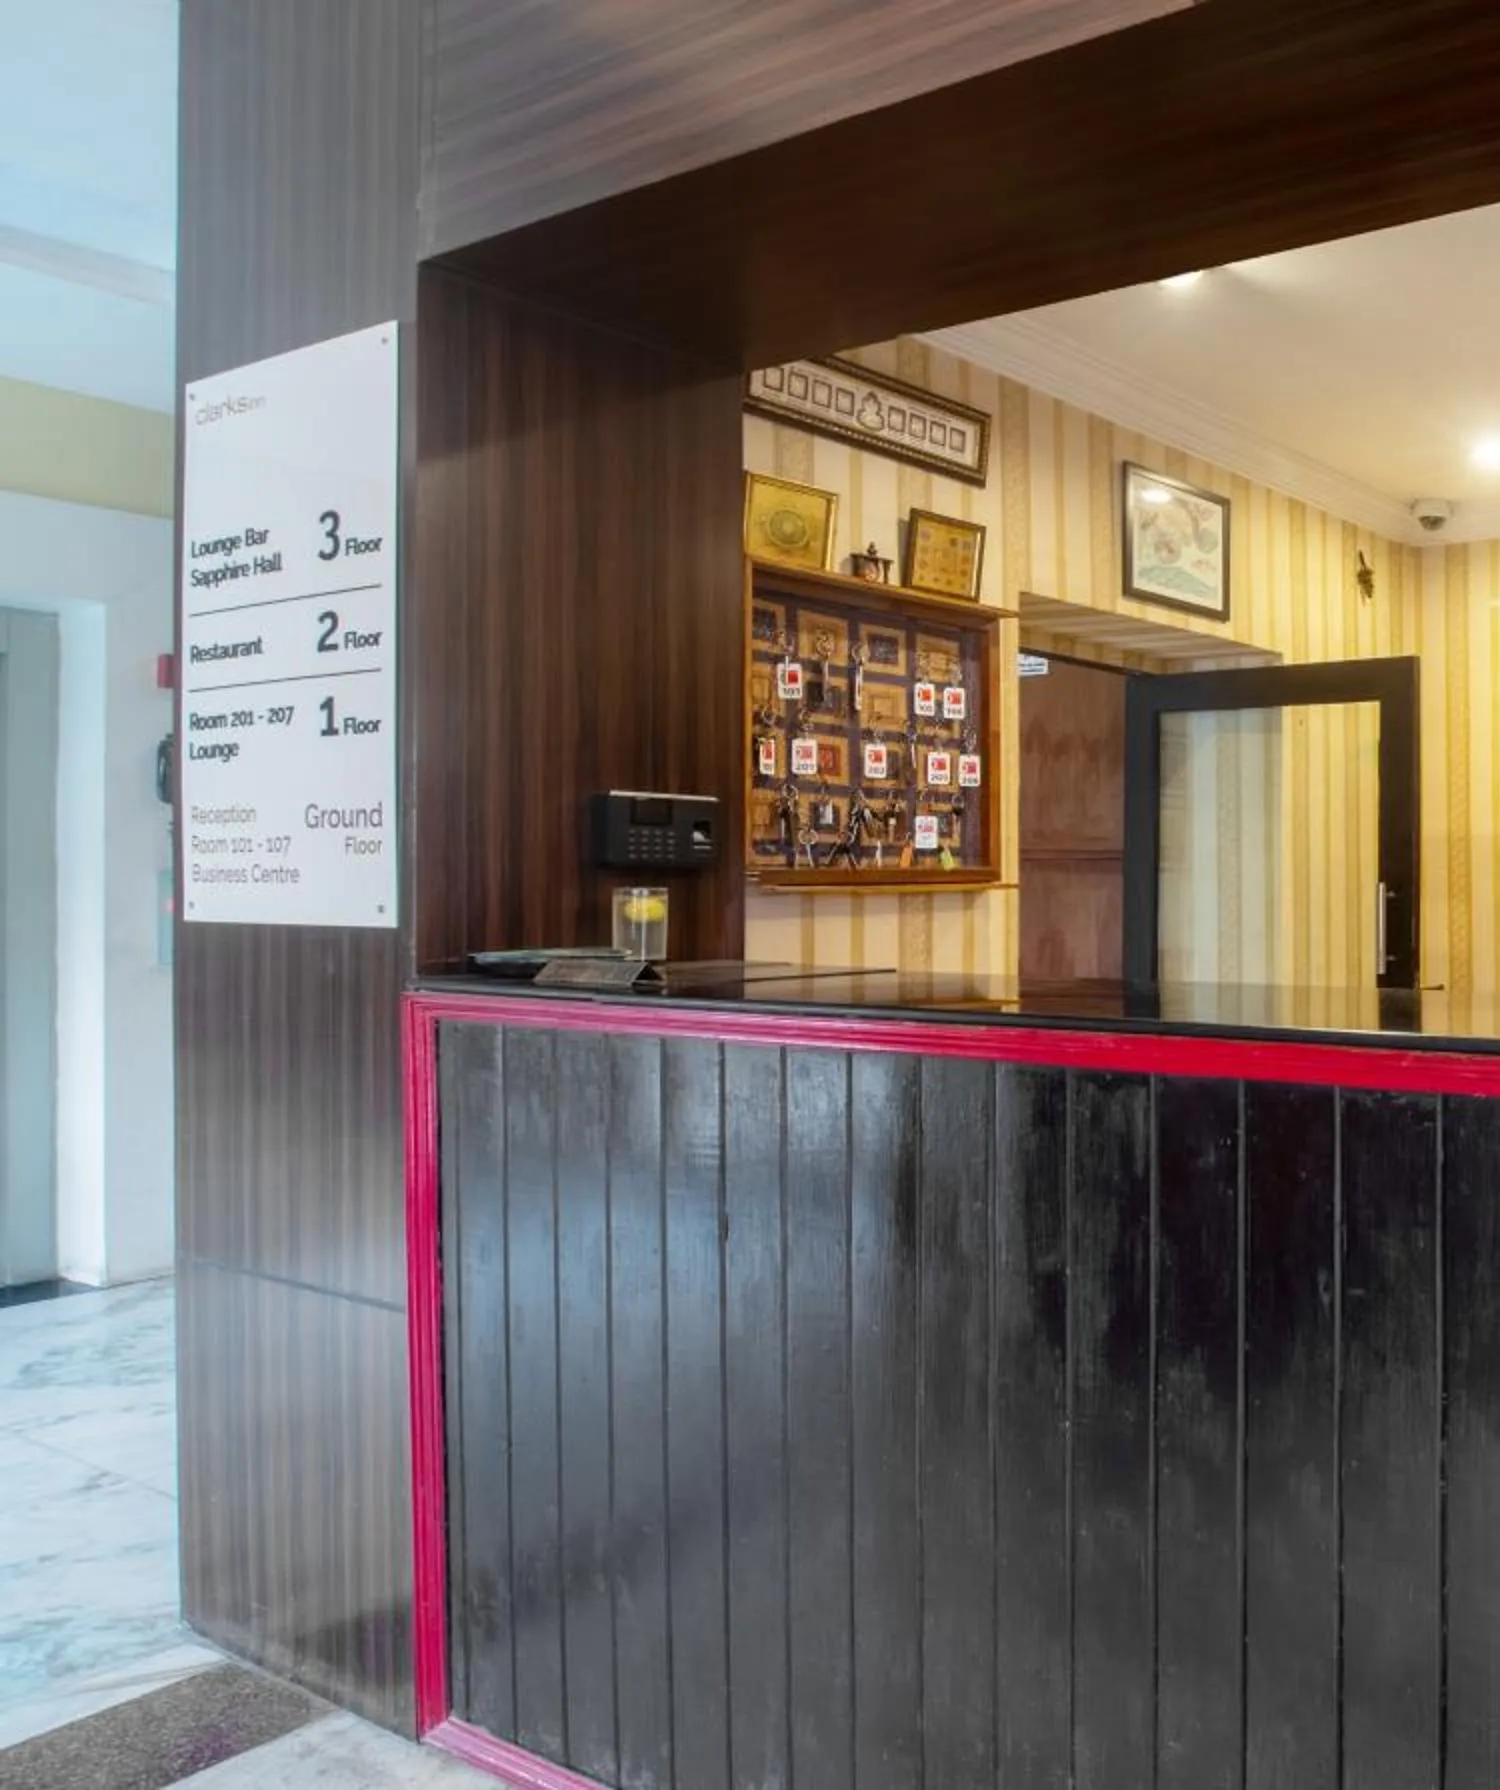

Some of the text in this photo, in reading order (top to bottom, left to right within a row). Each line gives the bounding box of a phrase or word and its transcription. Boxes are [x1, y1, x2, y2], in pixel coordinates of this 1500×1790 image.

[191, 527, 270, 559] Lounge Bar
[317, 509, 383, 561] 3 Floor
[190, 552, 283, 589] Sapphire Hall
[317, 610, 383, 653] 2 Floor
[190, 636, 264, 664] Restaurant
[189, 711, 228, 732] Room
[230, 710, 254, 726] 201
[267, 706, 295, 726] 207
[319, 696, 382, 738] 1 Floor
[189, 740, 240, 763] Lounge
[191, 804, 257, 827] Reception
[304, 802, 383, 830] Ground
[192, 836, 228, 855] Room
[230, 837, 254, 853] 101
[266, 836, 292, 857] 107
[344, 836, 382, 856] Floor
[192, 863, 300, 884] Business Centre
